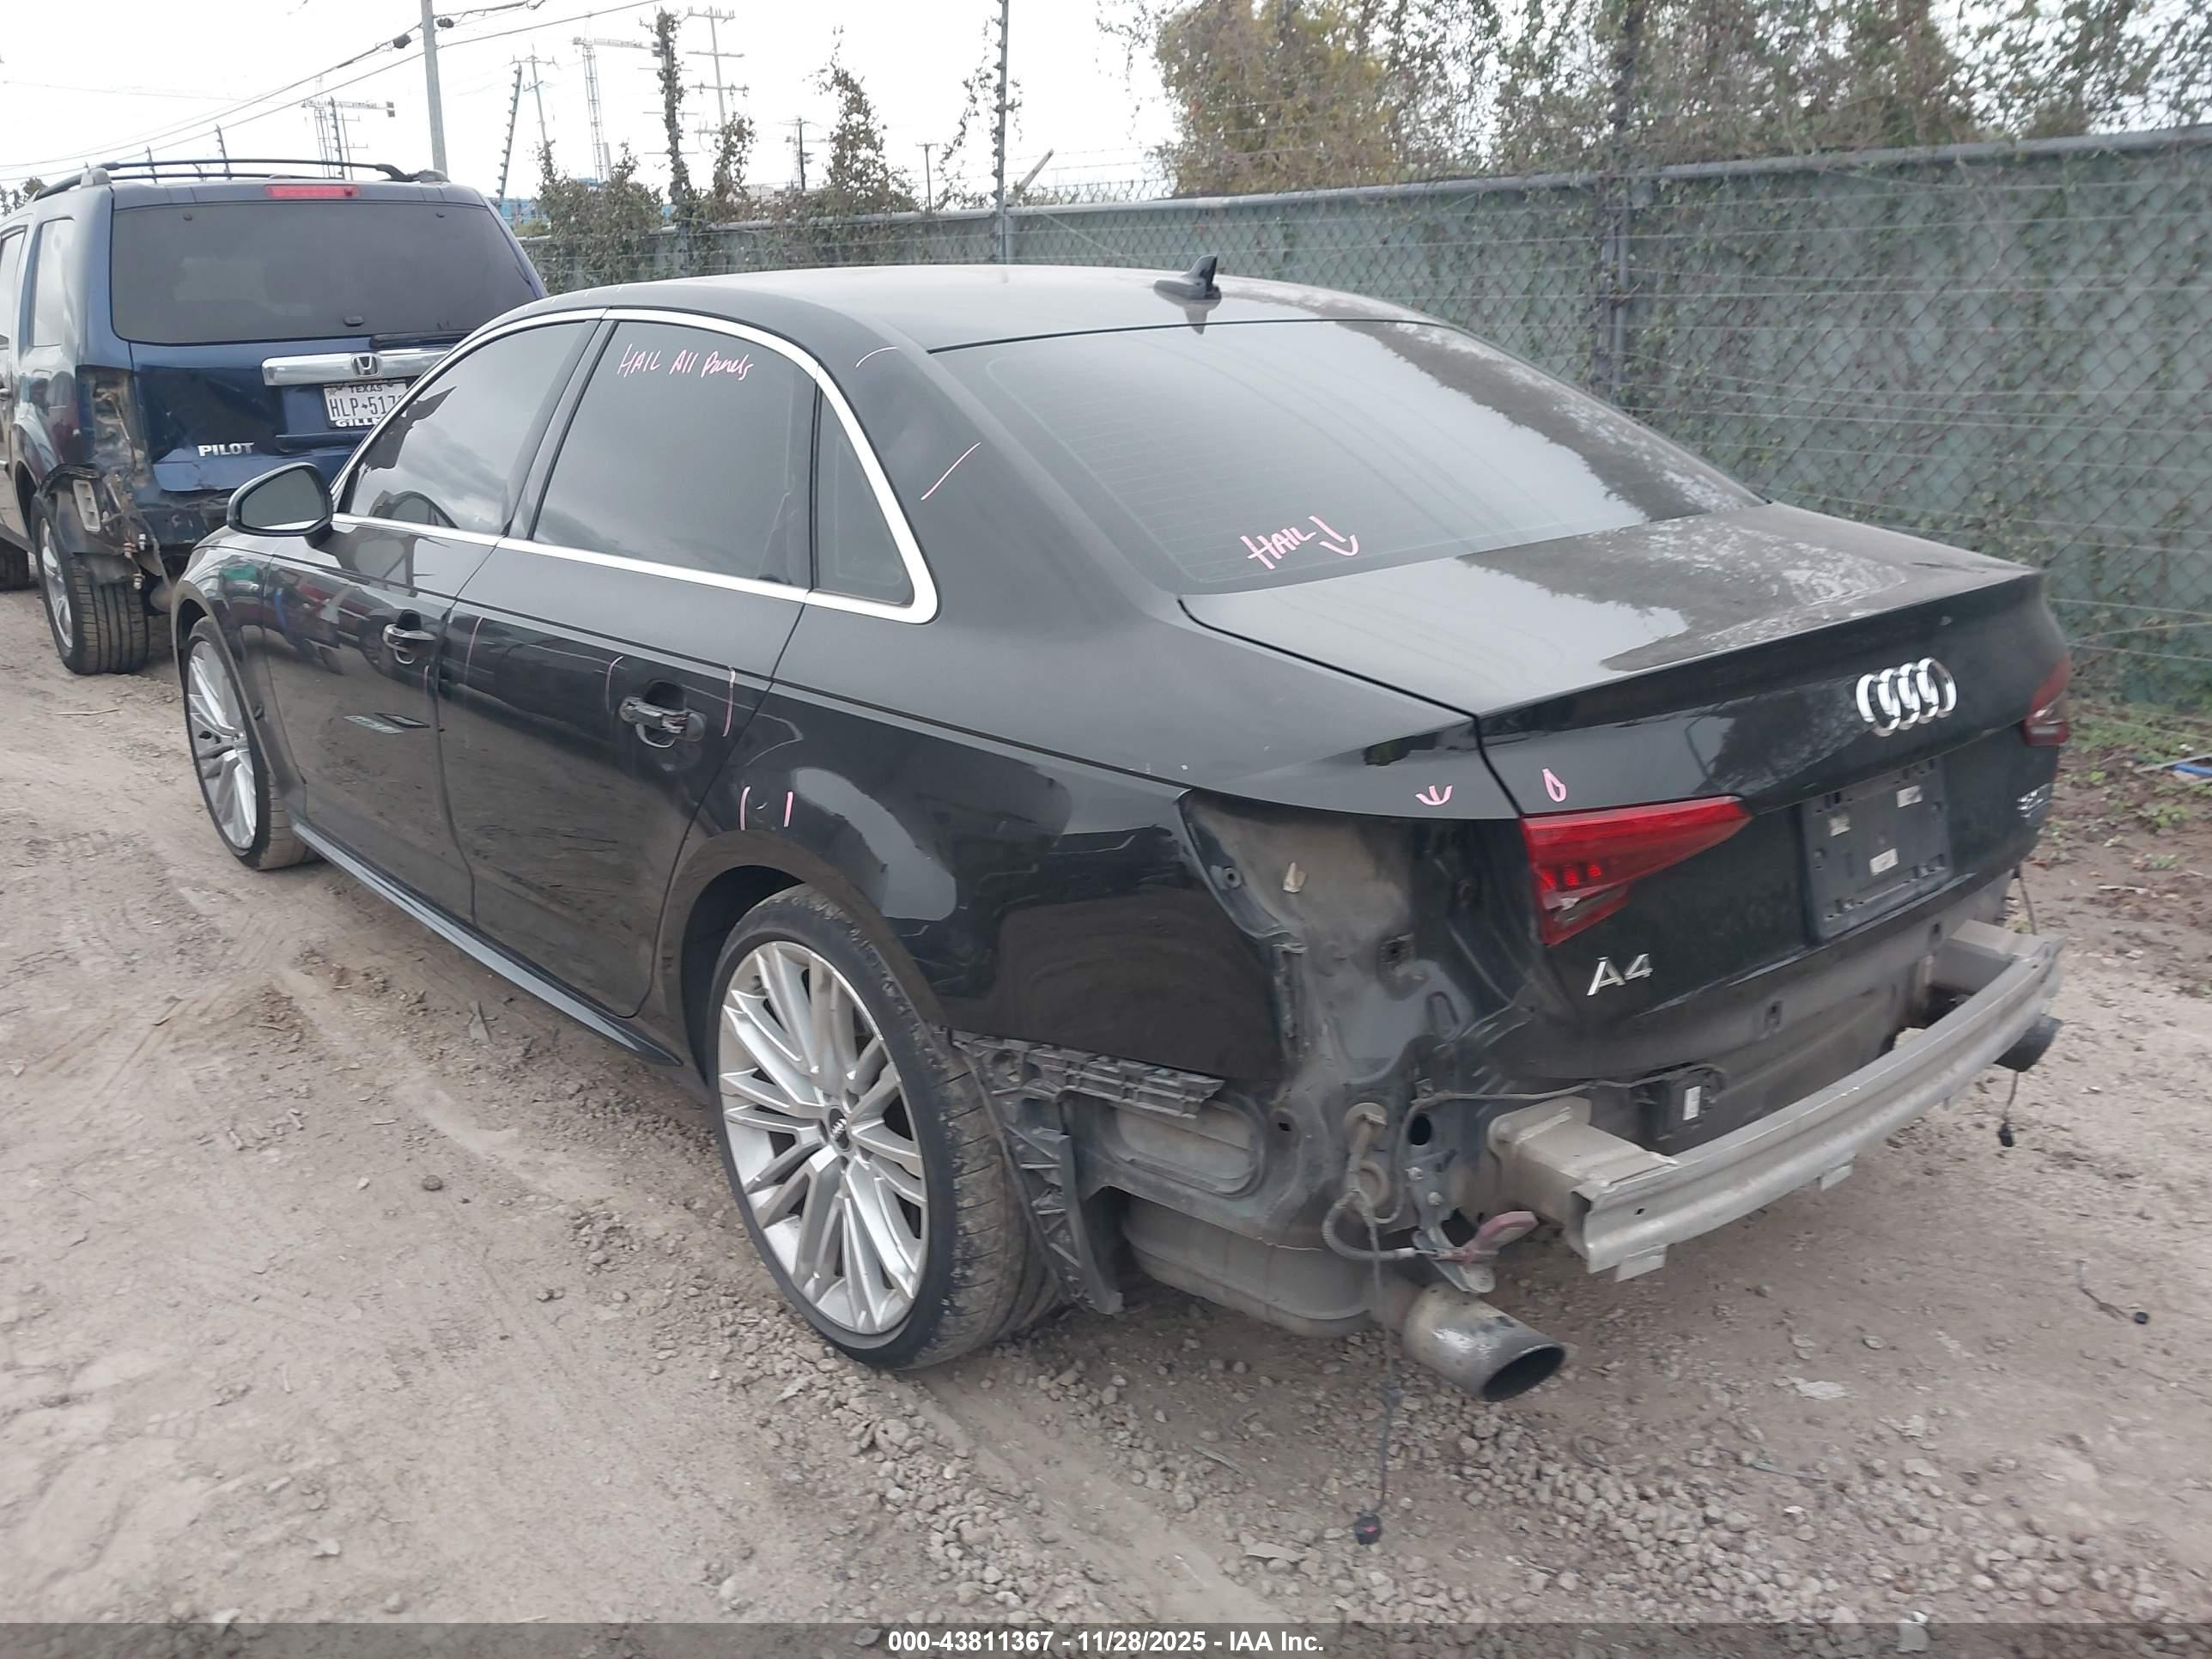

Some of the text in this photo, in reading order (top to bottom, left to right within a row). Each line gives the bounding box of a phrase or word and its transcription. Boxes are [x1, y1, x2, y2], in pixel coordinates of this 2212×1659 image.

[617, 343, 661, 378] HAIL
[349, 384, 383, 393] TEXAS
[197, 441, 255, 457] PILOT
[1239, 526, 1317, 570] HAIL
[1586, 953, 1654, 996] A4
